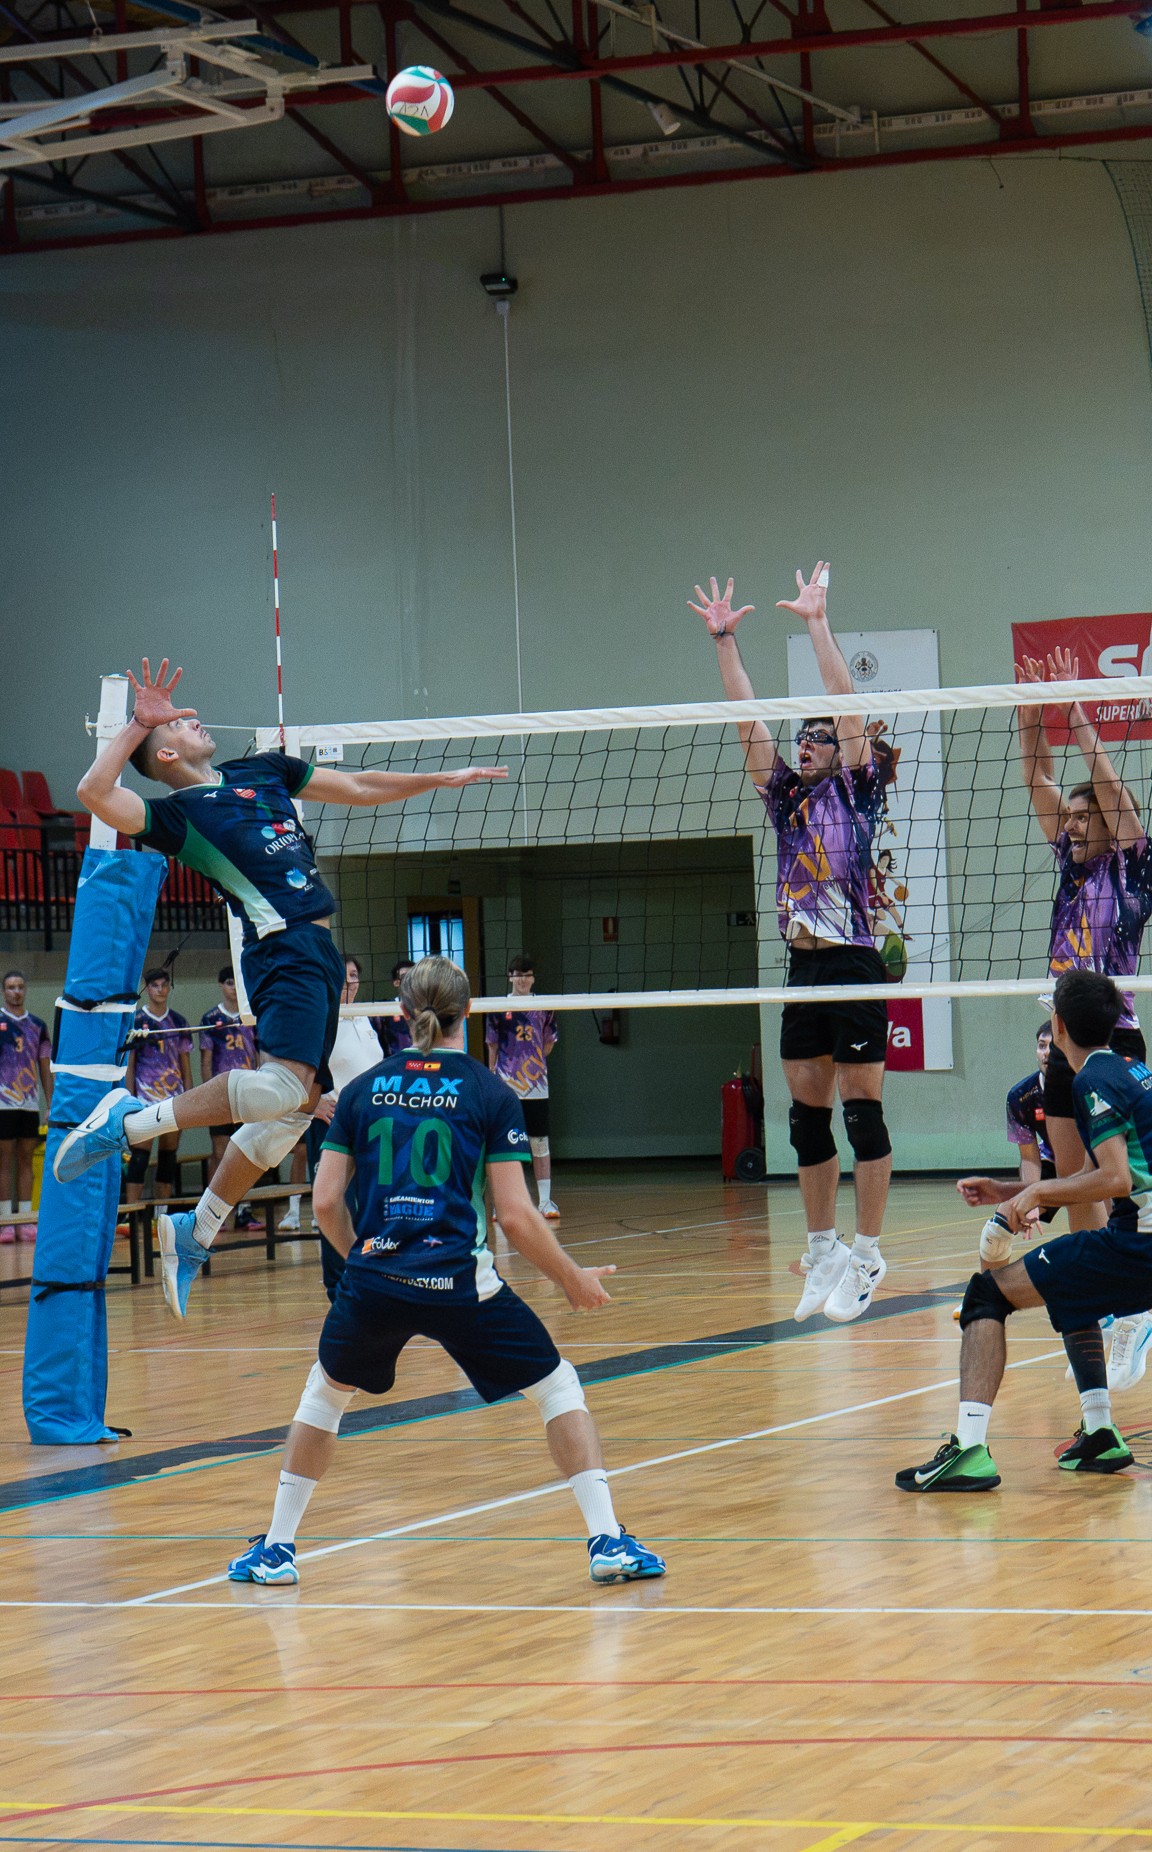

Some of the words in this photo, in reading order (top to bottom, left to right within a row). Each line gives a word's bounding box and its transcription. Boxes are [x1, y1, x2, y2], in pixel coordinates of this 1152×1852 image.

[1098, 640, 1152, 677] S
[225, 1034, 244, 1050] 24
[515, 1025, 533, 1041] 23
[15, 1036, 23, 1052] 3
[1128, 1061, 1152, 1081] MA
[371, 1075, 464, 1095] MAX
[371, 1093, 458, 1109] COLCHON
[367, 1116, 453, 1188] 10
